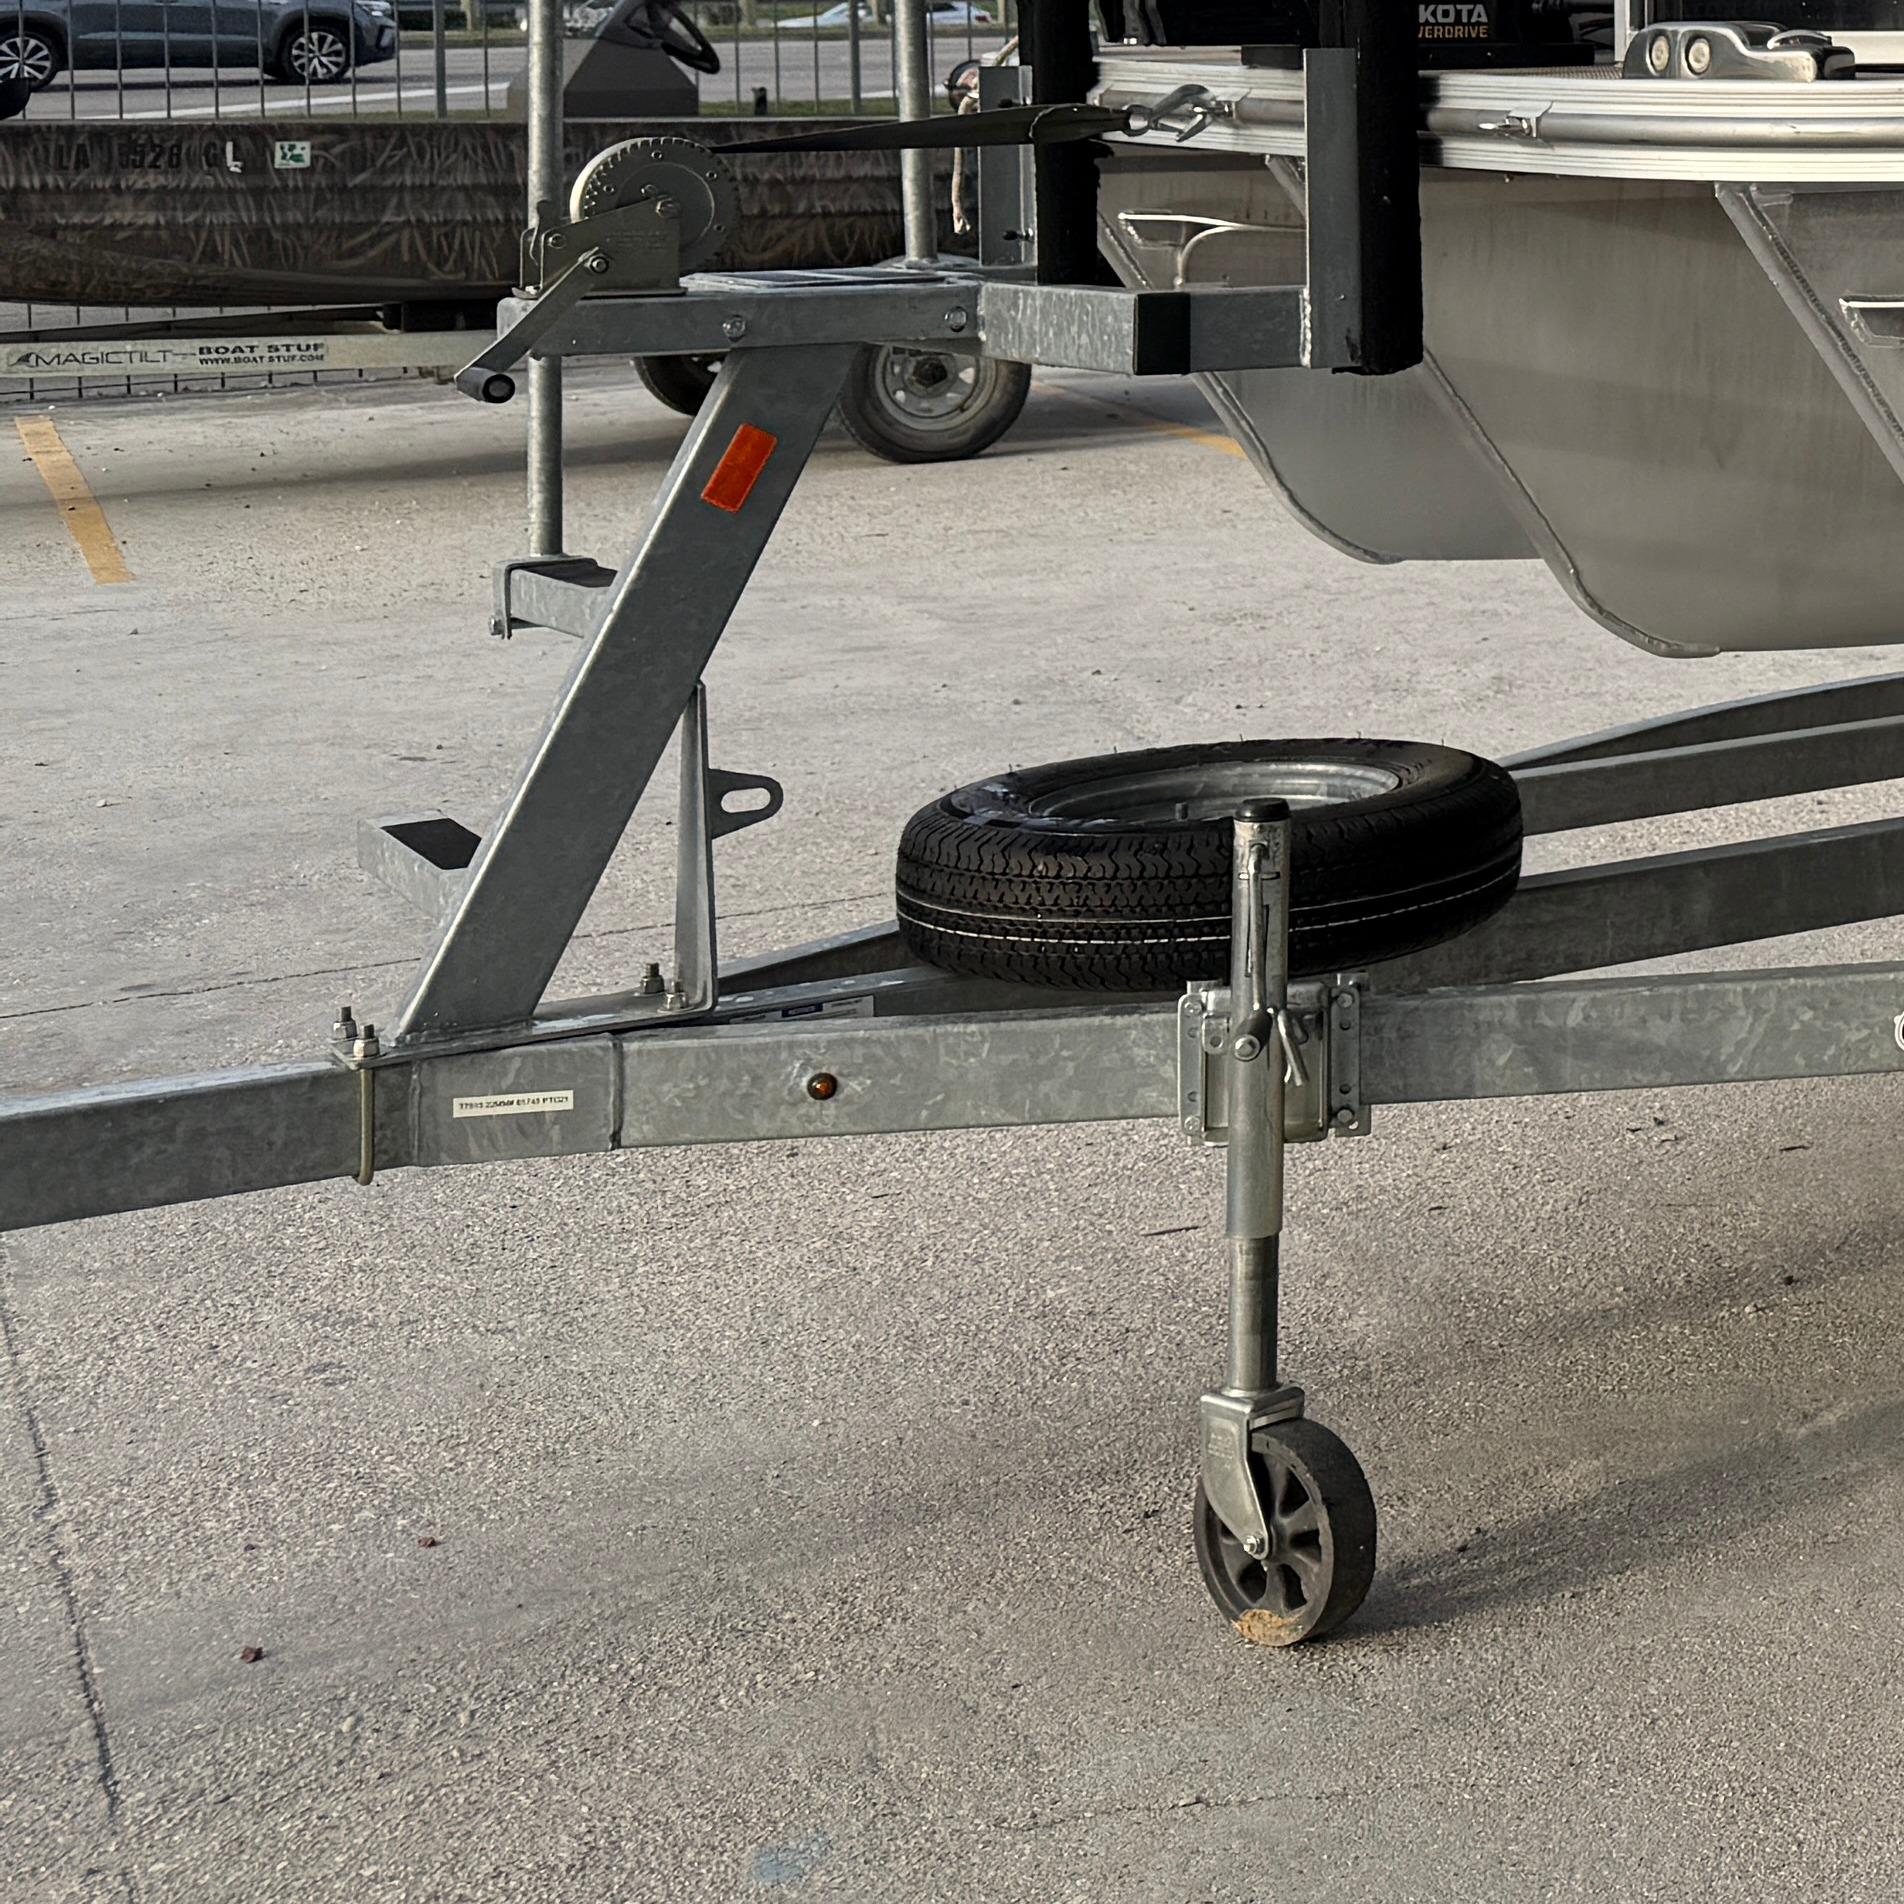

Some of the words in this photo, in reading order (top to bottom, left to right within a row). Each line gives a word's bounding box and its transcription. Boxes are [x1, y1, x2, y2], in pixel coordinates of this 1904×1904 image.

[1418, 4, 1488, 23] KOTA
[35, 349, 173, 366] MAGICTILT
[198, 343, 259, 356] BOAT
